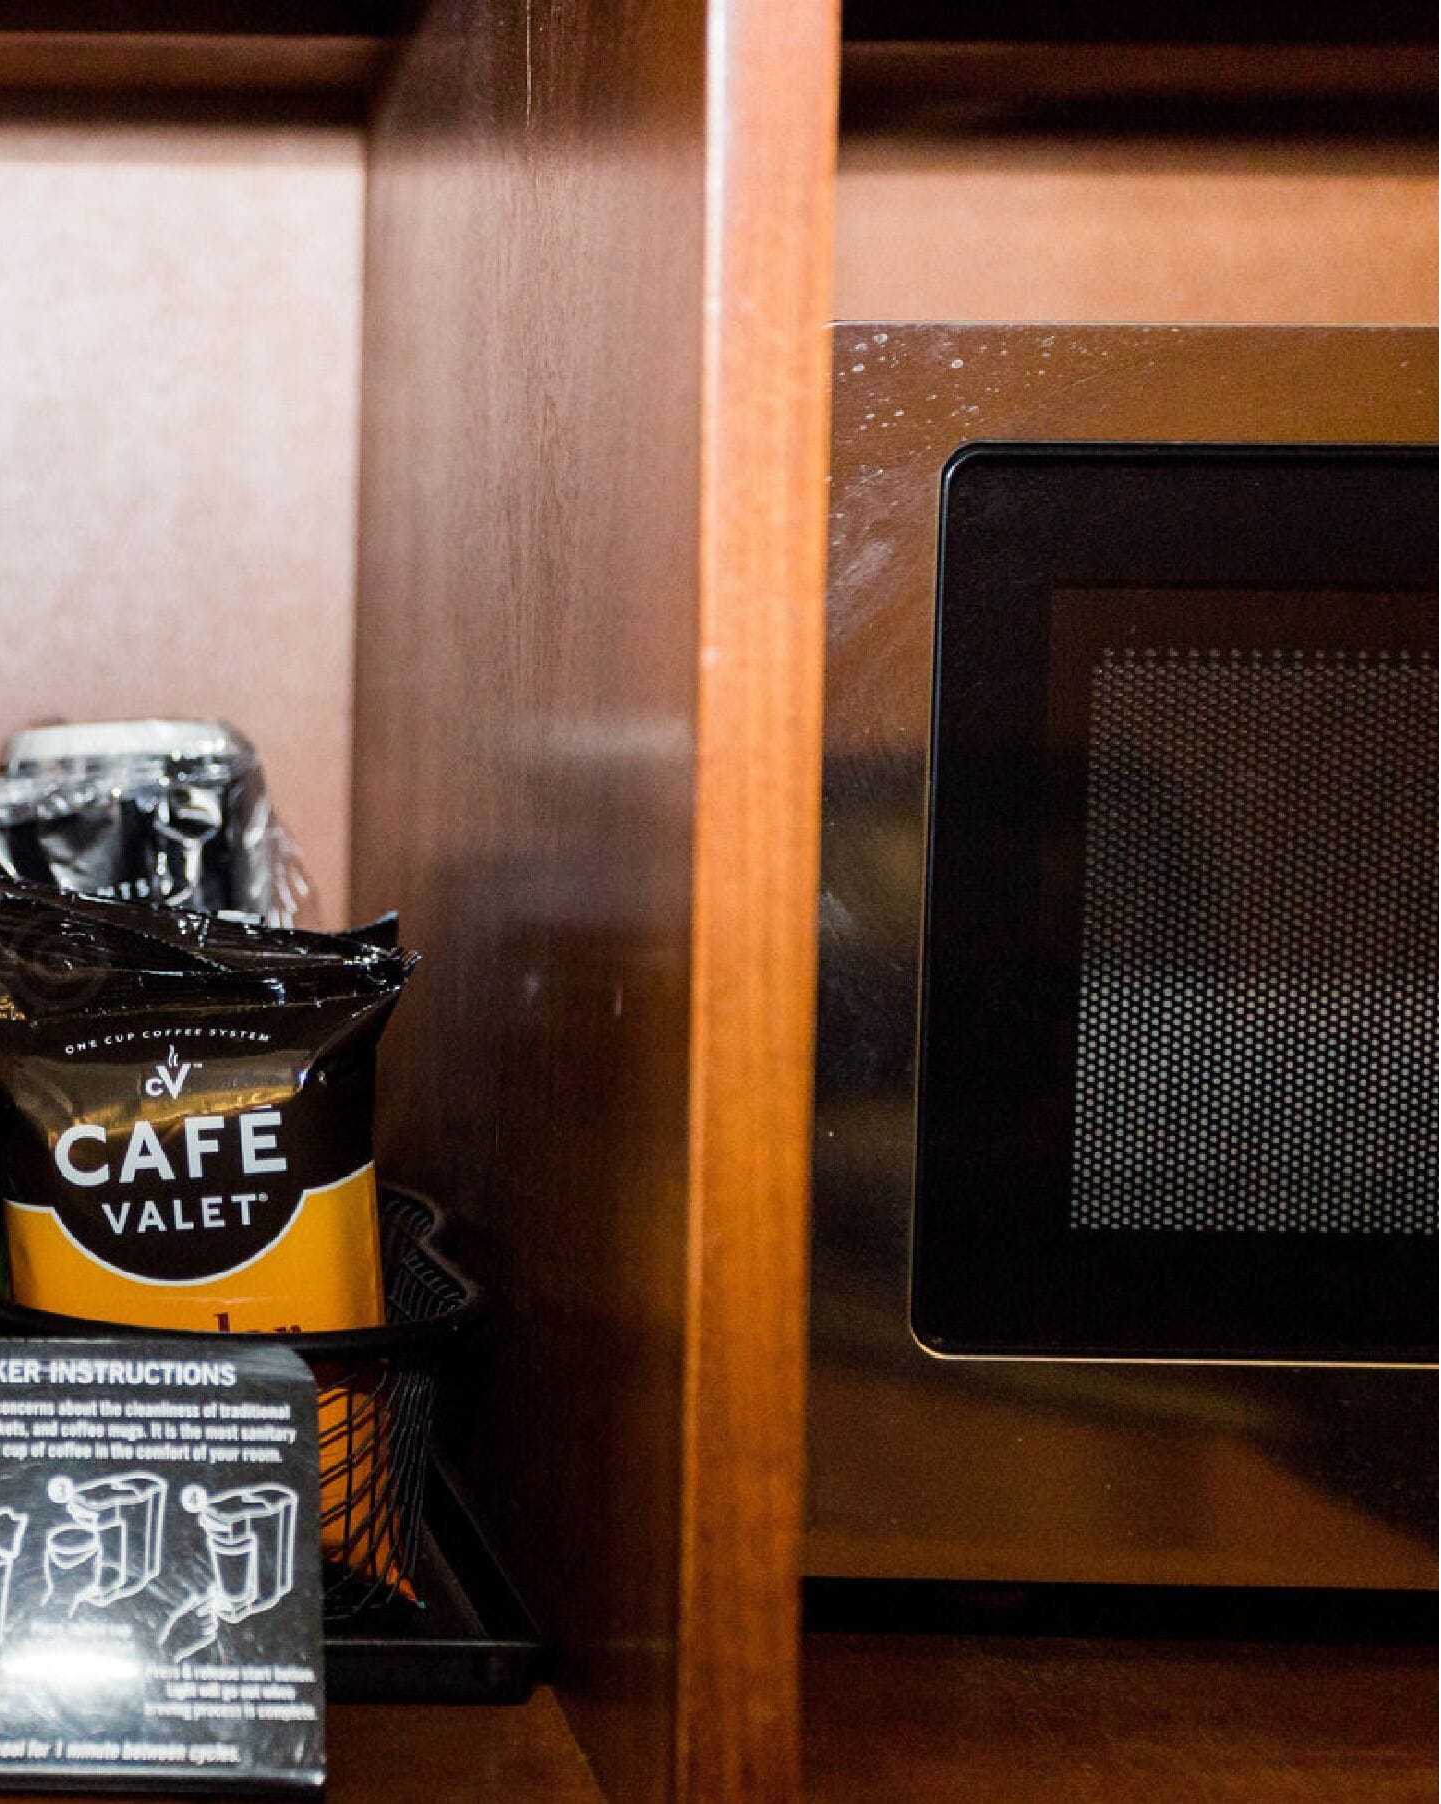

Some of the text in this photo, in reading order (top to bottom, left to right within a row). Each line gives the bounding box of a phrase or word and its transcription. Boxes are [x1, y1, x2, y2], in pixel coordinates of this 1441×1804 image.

[65, 1028, 271, 1055] ONE CUP COFFEE SYSTEM
[54, 1104, 287, 1186] CAFÉ
[49, 1359, 238, 1386] INSTRUCTIONS
[58, 1400, 98, 1417] about
[100, 1400, 122, 1417] the
[124, 1401, 200, 1419] cleanliness
[203, 1402, 218, 1419] of
[220, 1403, 291, 1421] traditional
[33, 1421, 58, 1438] and
[61, 1420, 105, 1439] coffee
[150, 1422, 161, 1440] It
[165, 1423, 177, 1440] is
[180, 1423, 202, 1441] the
[205, 1425, 239, 1442] most
[241, 1426, 297, 1444] sanitary
[3, 1443, 28, 1461] cup
[30, 1442, 45, 1458] of
[48, 1442, 92, 1459] coffee
[95, 1442, 108, 1459] in
[111, 1443, 133, 1460] the
[135, 1444, 190, 1462] comfort
[193, 1444, 207, 1462] of
[209, 1447, 240, 1465] your
[241, 1447, 283, 1465] room.
[28, 1738, 52, 1759] for
[67, 1739, 120, 1760] minute
[122, 1740, 187, 1761] between
